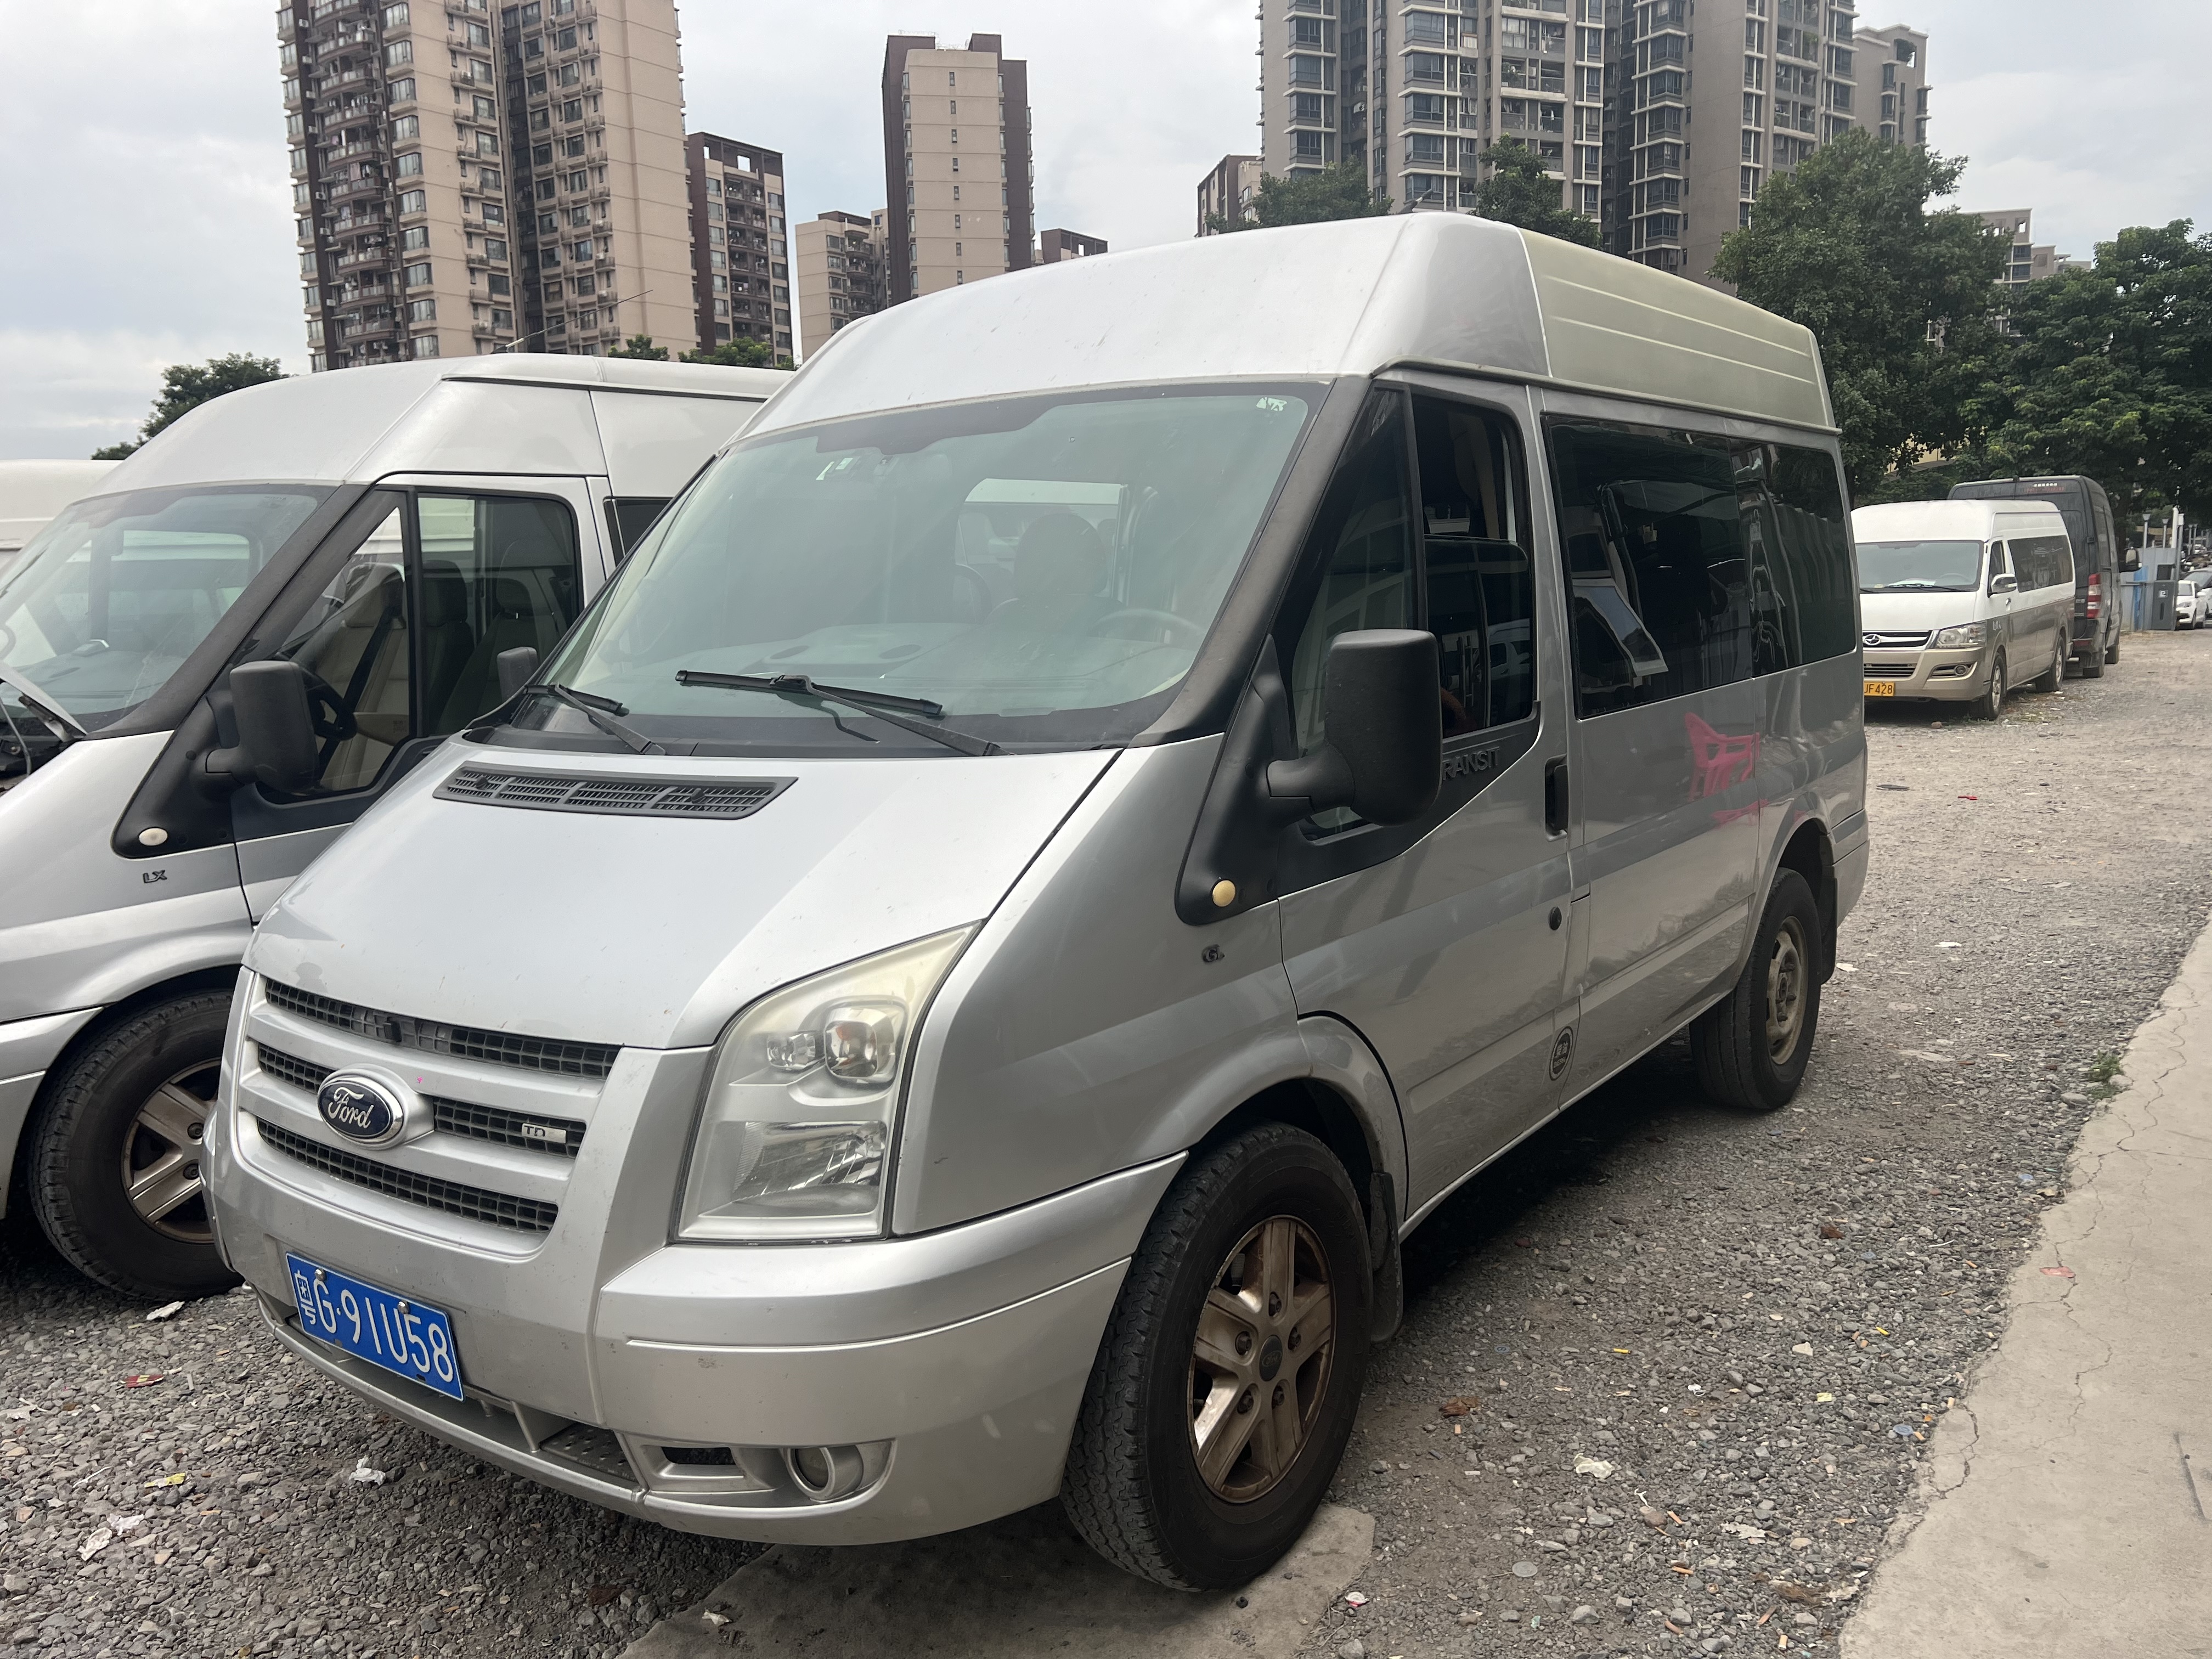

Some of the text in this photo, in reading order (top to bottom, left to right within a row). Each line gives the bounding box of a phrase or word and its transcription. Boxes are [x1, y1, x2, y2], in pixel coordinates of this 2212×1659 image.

[1442, 746, 1501, 781] RANSIT
[143, 870, 167, 883] LX
[328, 1086, 374, 1129] Ford
